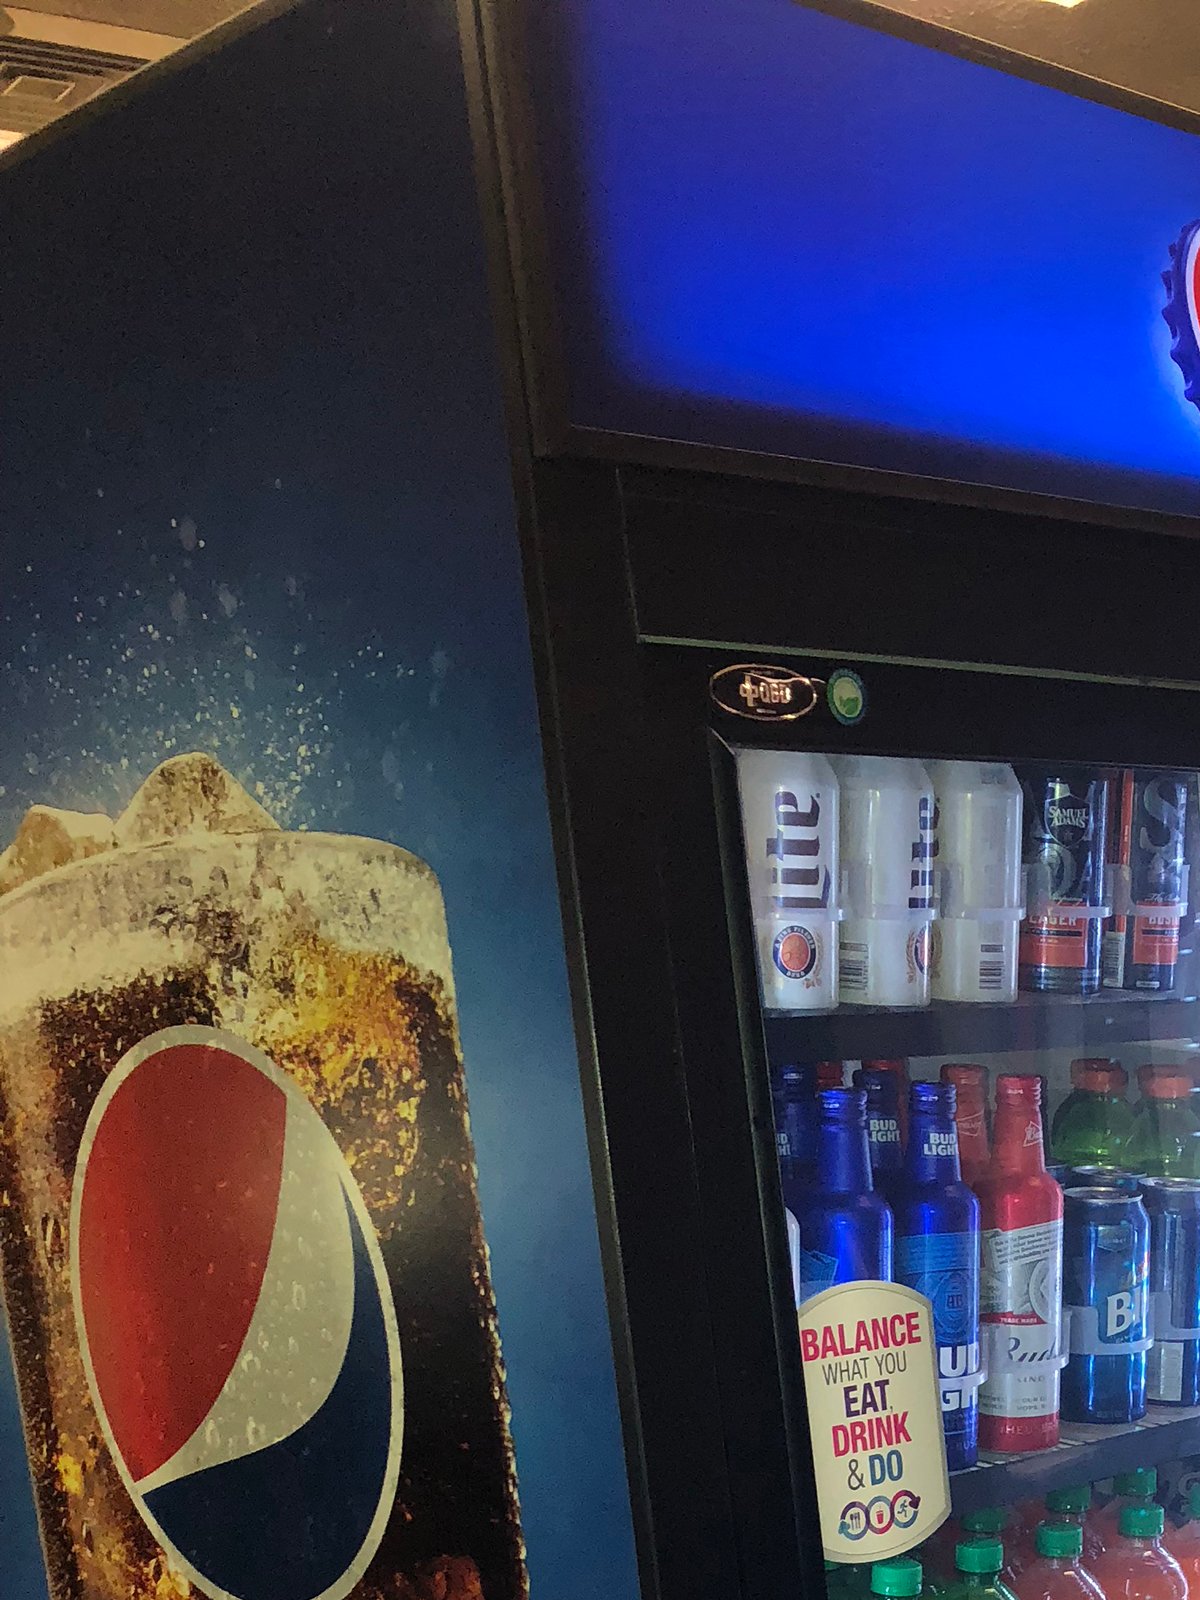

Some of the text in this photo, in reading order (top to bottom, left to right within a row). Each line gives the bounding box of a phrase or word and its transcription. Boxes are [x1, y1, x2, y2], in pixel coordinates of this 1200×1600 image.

[1049, 805, 1089, 820] SAMUEL
[1051, 815, 1087, 829] ADAMS
[766, 791, 831, 909] Lite
[870, 1119, 897, 1131] BUD
[929, 1132, 957, 1145] BUD
[801, 1311, 922, 1363] BALANCE
[822, 1350, 908, 1386] WHAT YOU
[832, 1410, 912, 1458] DRINK
[847, 1449, 904, 1491] & DO
